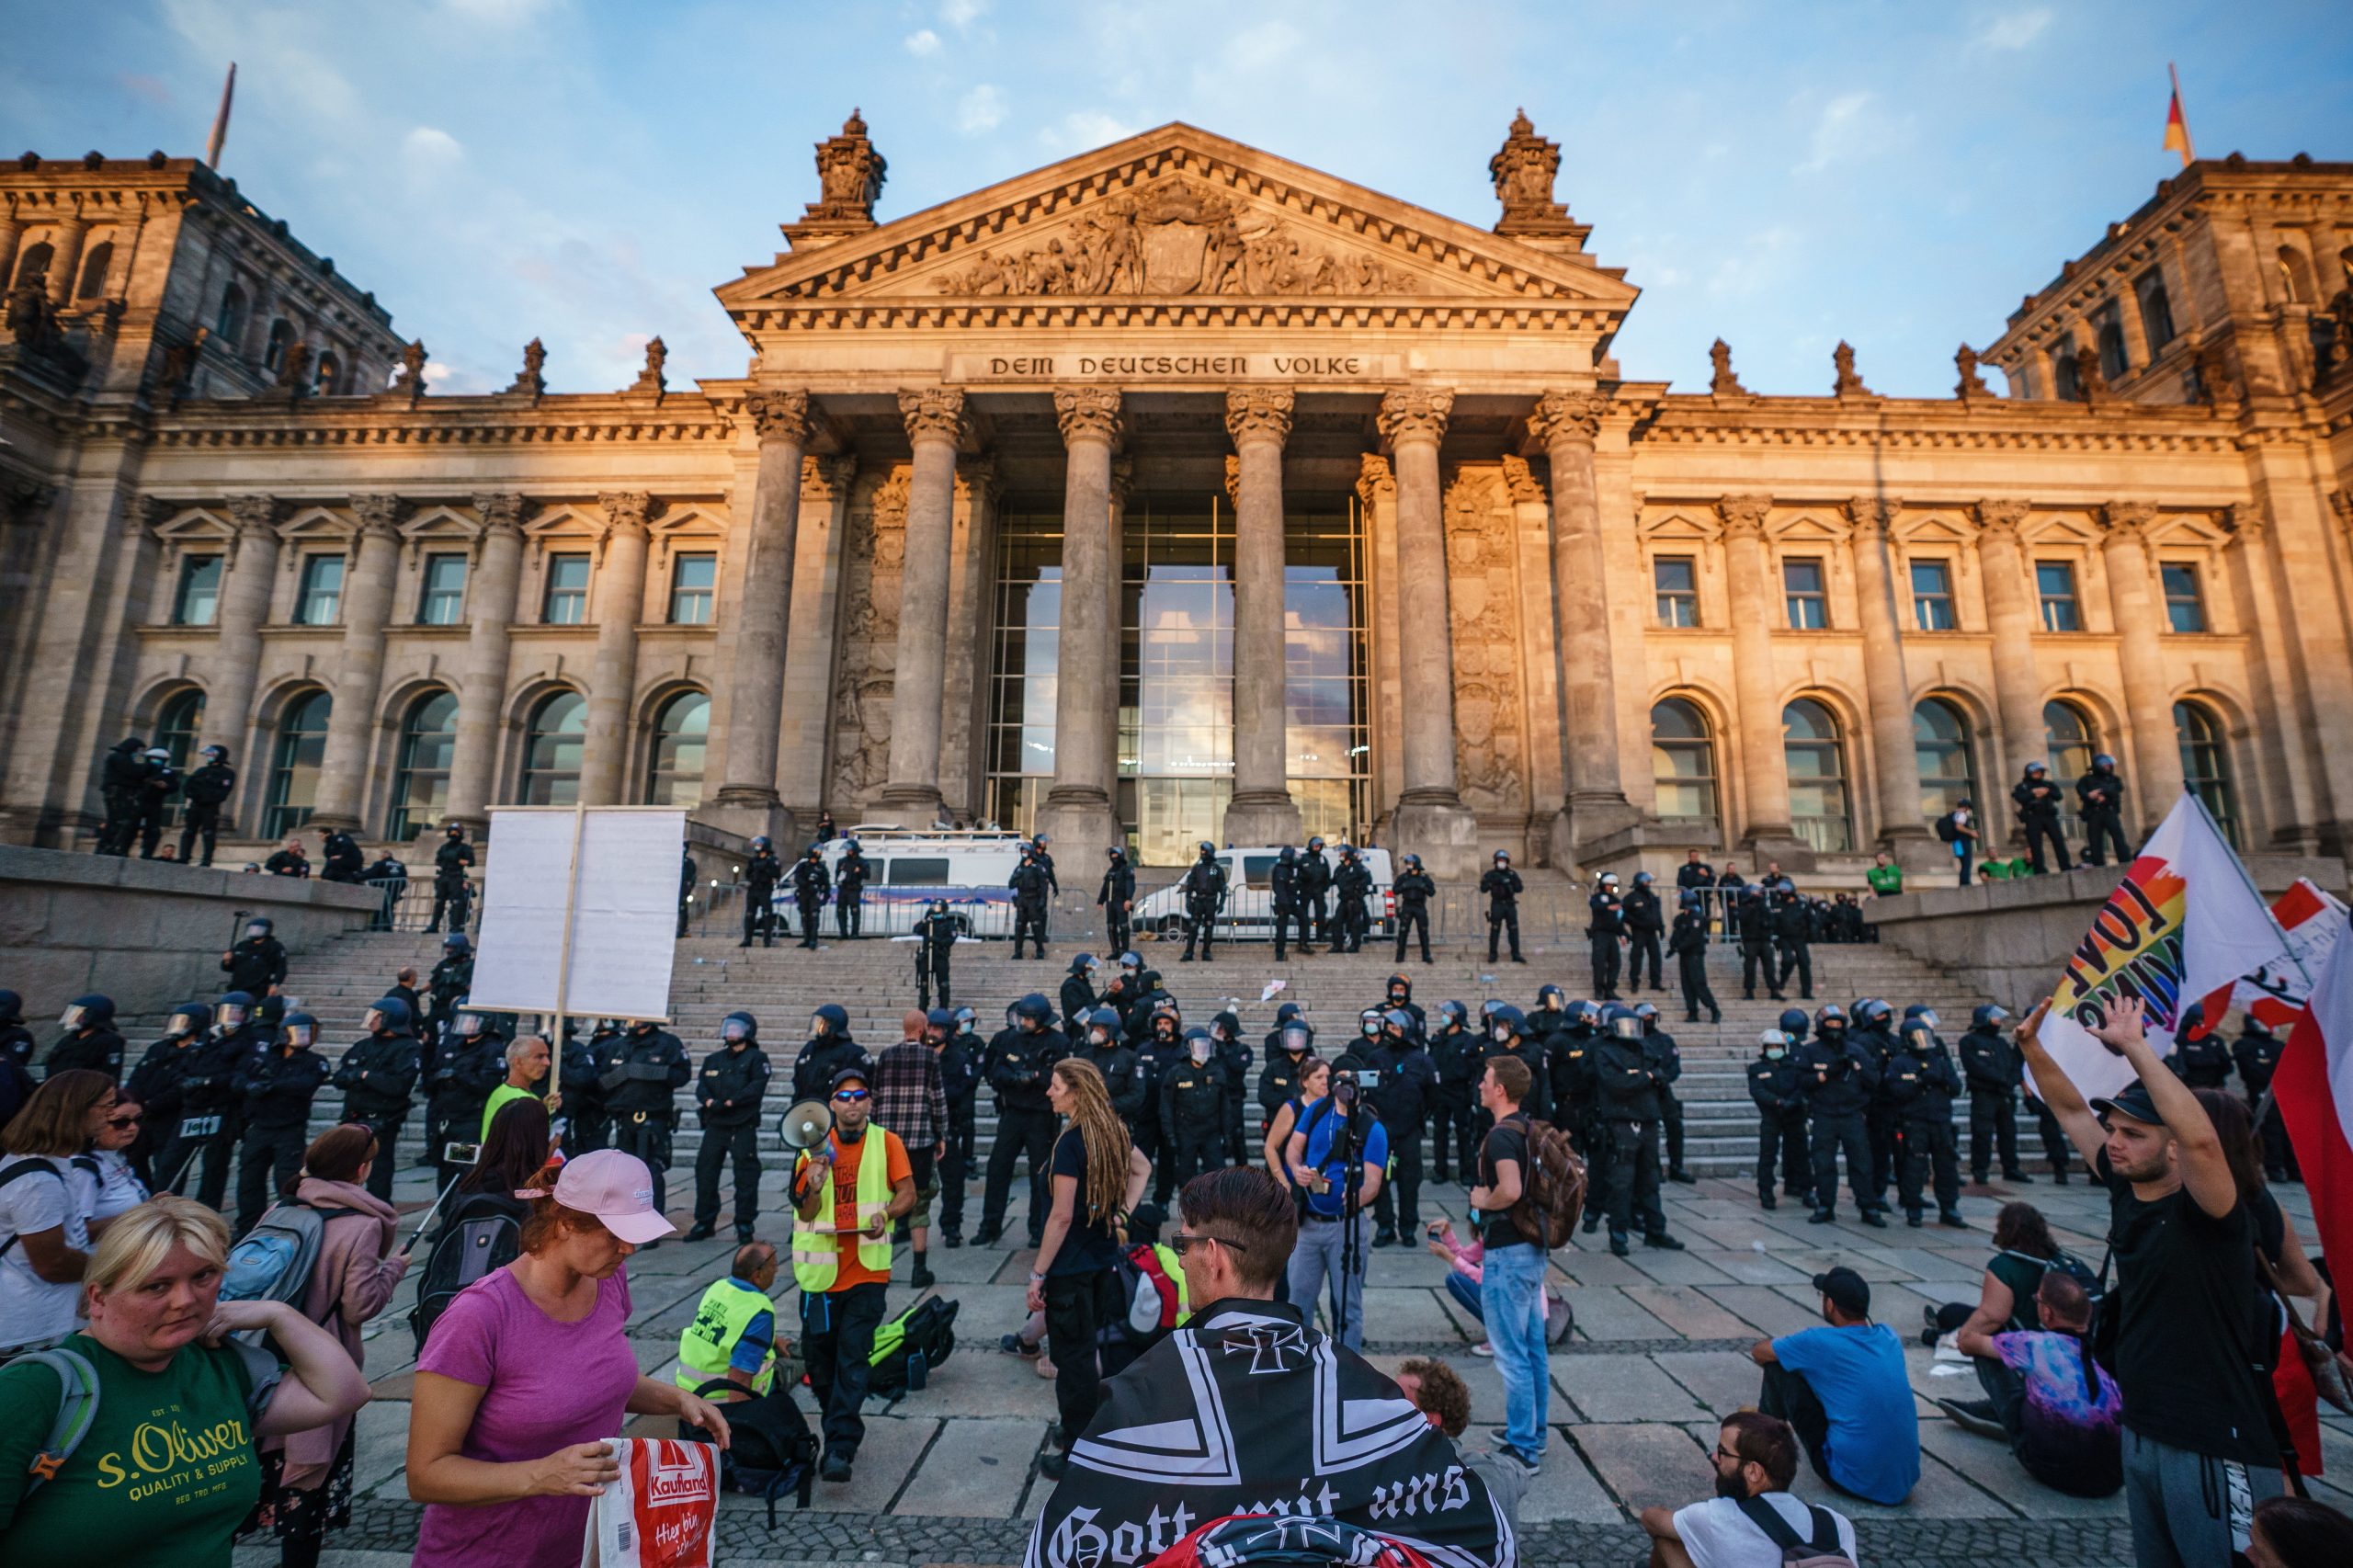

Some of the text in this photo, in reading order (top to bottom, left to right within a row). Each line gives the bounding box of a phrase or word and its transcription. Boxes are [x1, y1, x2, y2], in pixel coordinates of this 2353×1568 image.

[990, 357, 1360, 375] DEM DEUTSCHEN VOLKE
[97, 1419, 248, 1489] s.Oliver
[129, 1453, 248, 1502] QUALITY & SUPPLY
[651, 1471, 708, 1496] Kaufland
[655, 1522, 680, 1547] Hier
[682, 1512, 699, 1533] bin
[1047, 1500, 1196, 1568] Gott
[1369, 1465, 1471, 1520] uns
